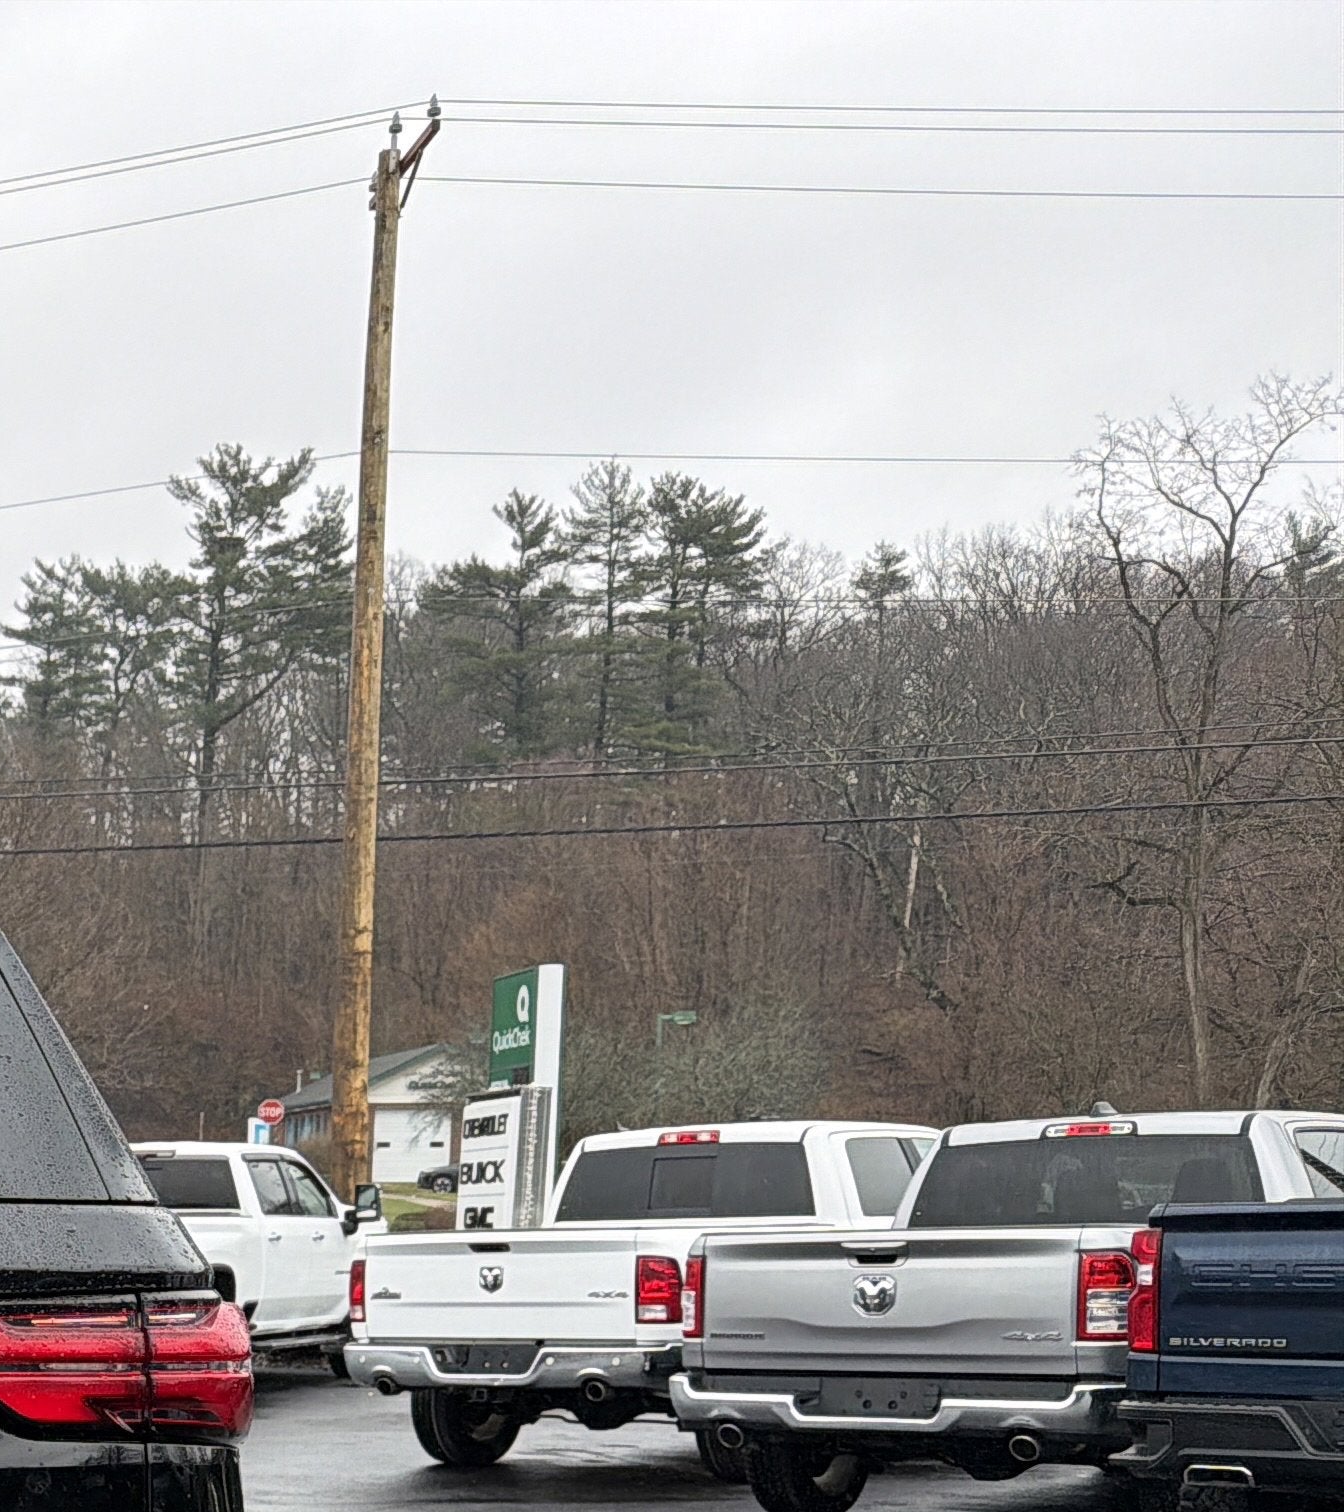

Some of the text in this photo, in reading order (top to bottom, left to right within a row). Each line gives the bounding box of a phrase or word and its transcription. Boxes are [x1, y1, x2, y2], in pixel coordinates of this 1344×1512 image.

[493, 1025, 531, 1055] QuickChek
[260, 1106, 282, 1118] STOP
[460, 1159, 506, 1185] BUICK
[1192, 1253, 1344, 1287] CHE
[1168, 1336, 1287, 1348] SILVERADO
